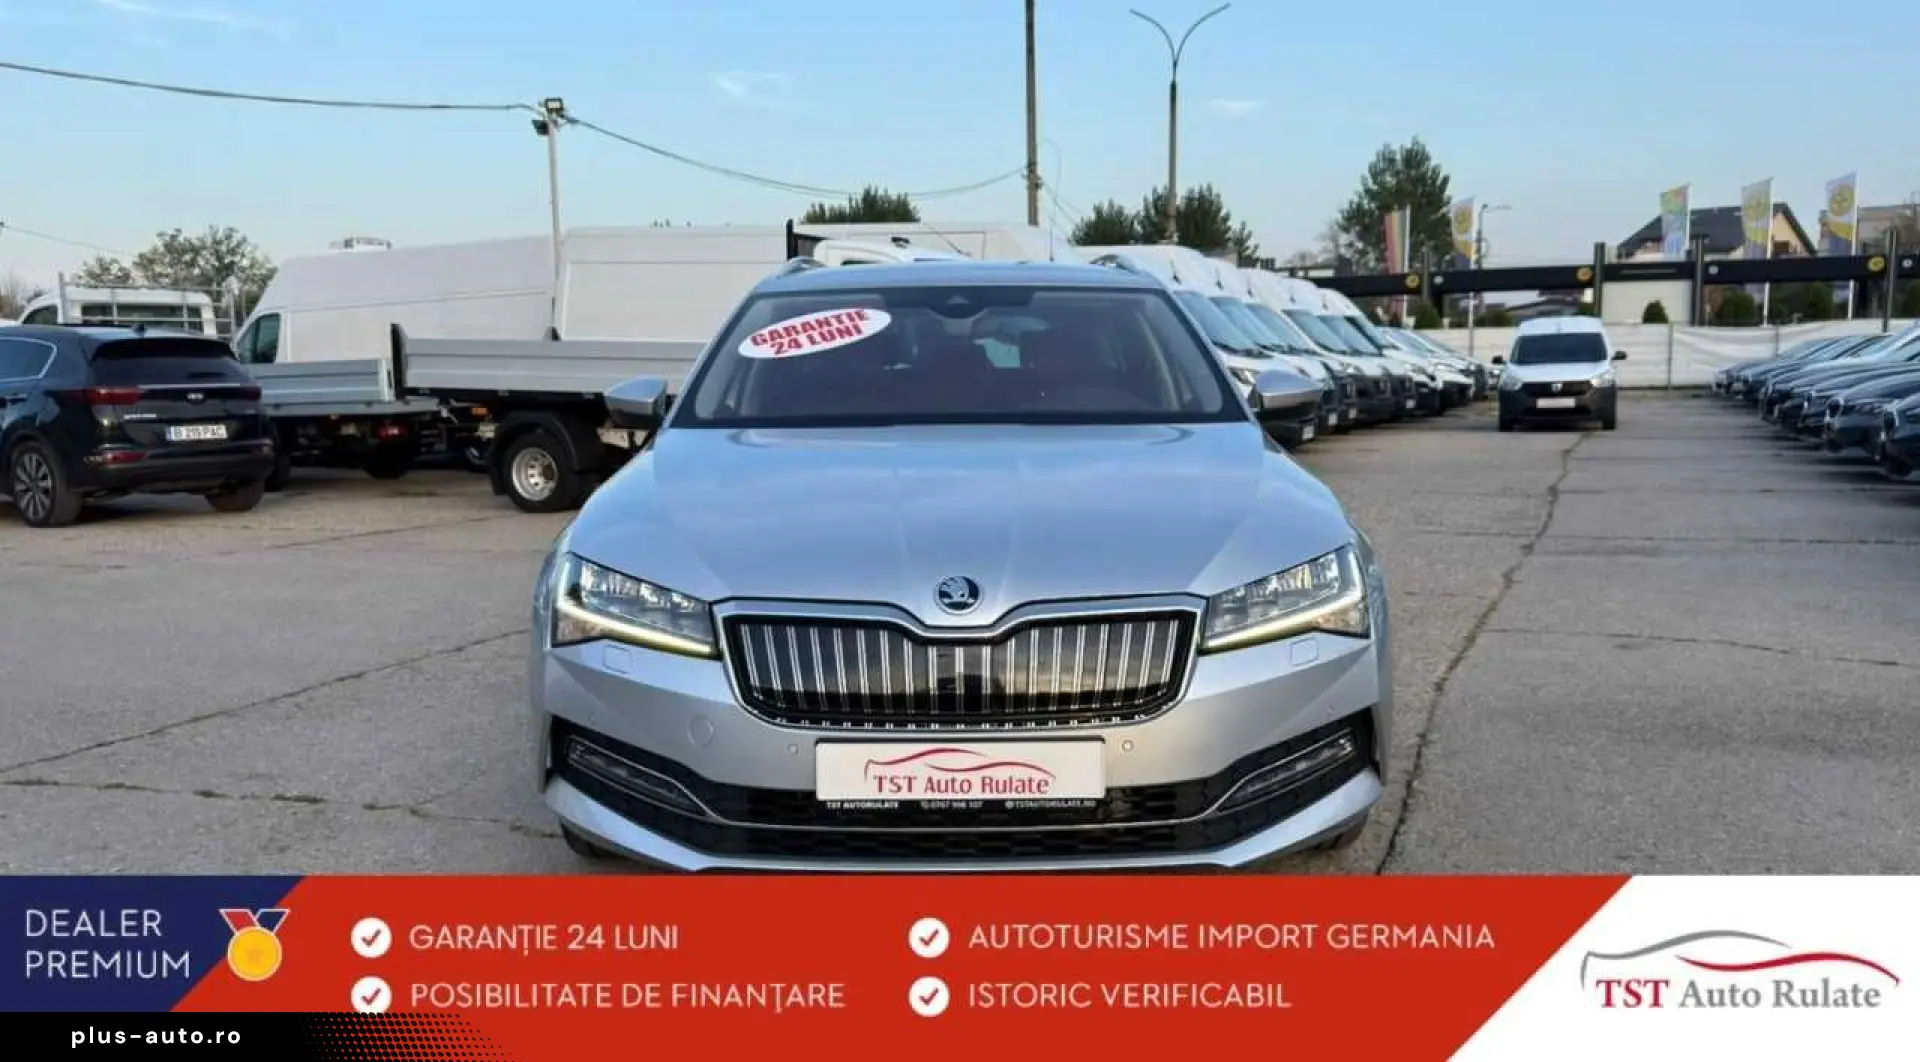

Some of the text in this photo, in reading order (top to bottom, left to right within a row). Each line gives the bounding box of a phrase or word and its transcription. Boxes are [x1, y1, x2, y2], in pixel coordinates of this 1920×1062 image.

[771, 323, 863, 356] 24 LUNI
[873, 775, 1050, 794] TST Auto Rulate
